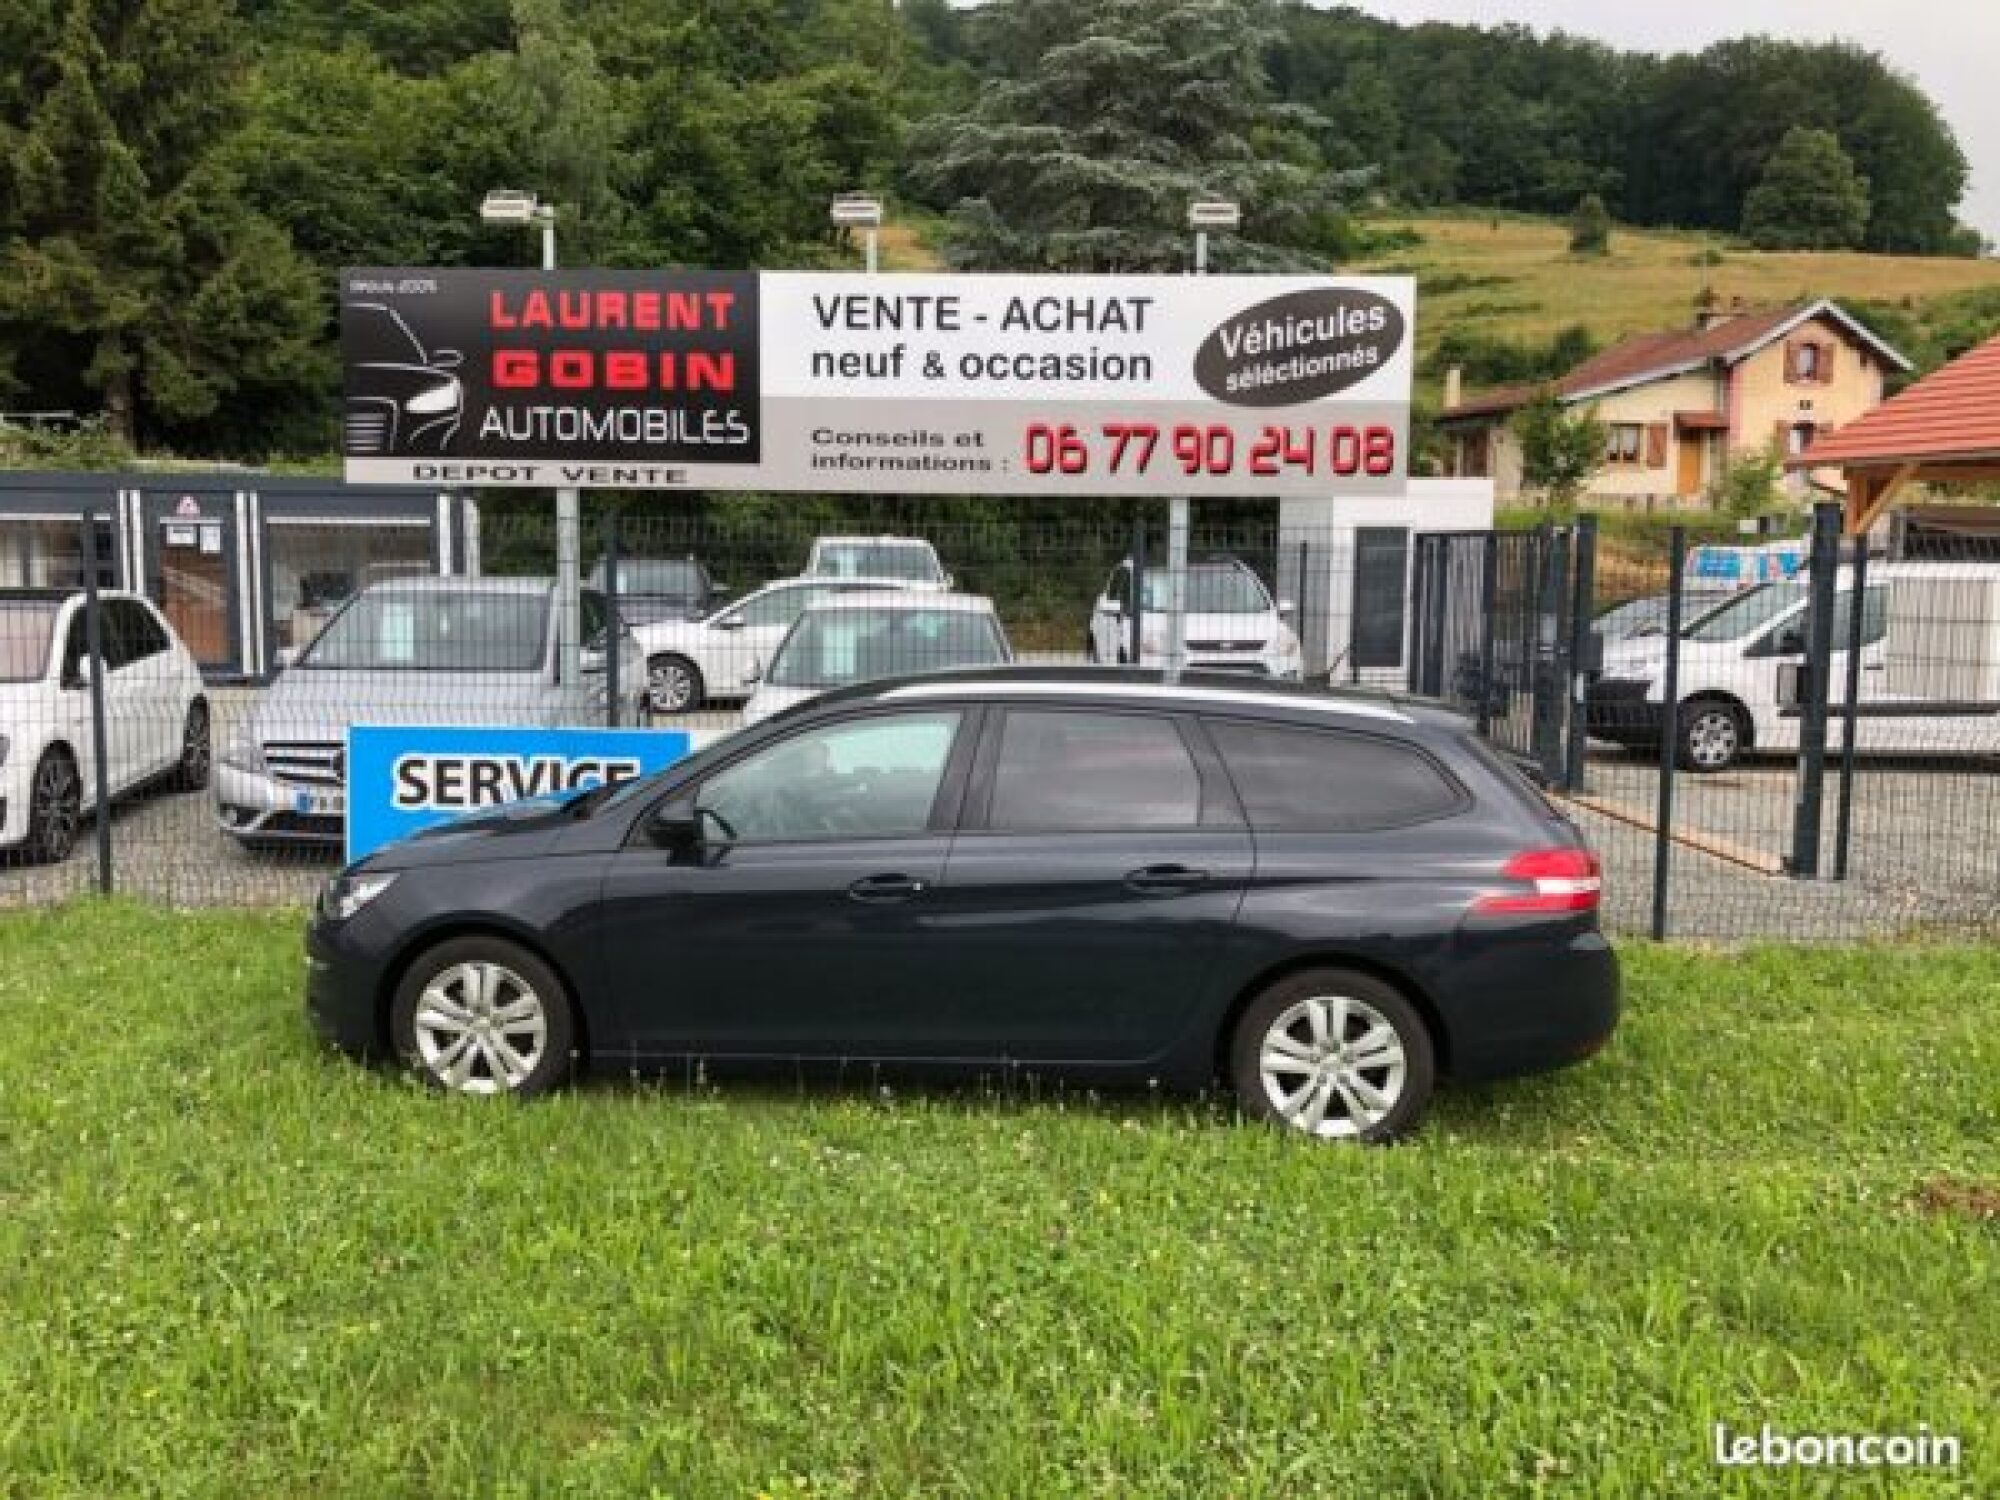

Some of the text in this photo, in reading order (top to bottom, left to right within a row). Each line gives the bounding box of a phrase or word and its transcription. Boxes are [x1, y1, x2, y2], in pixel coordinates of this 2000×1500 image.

[490, 289, 735, 330] LAURENT
[812, 294, 961, 331] VENTE
[1000, 295, 1154, 332] ACHAT
[1219, 304, 1388, 358] Véhicules
[493, 351, 735, 390] GOBIN
[812, 343, 1152, 381] neuf & occasion
[479, 406, 750, 444] AUTOMOBILES
[812, 428, 984, 447] Conseils et
[811, 453, 991, 471] informations
[1026, 424, 1395, 477] 06 77 90 24 08
[413, 463, 688, 484] DEPOT VENTE
